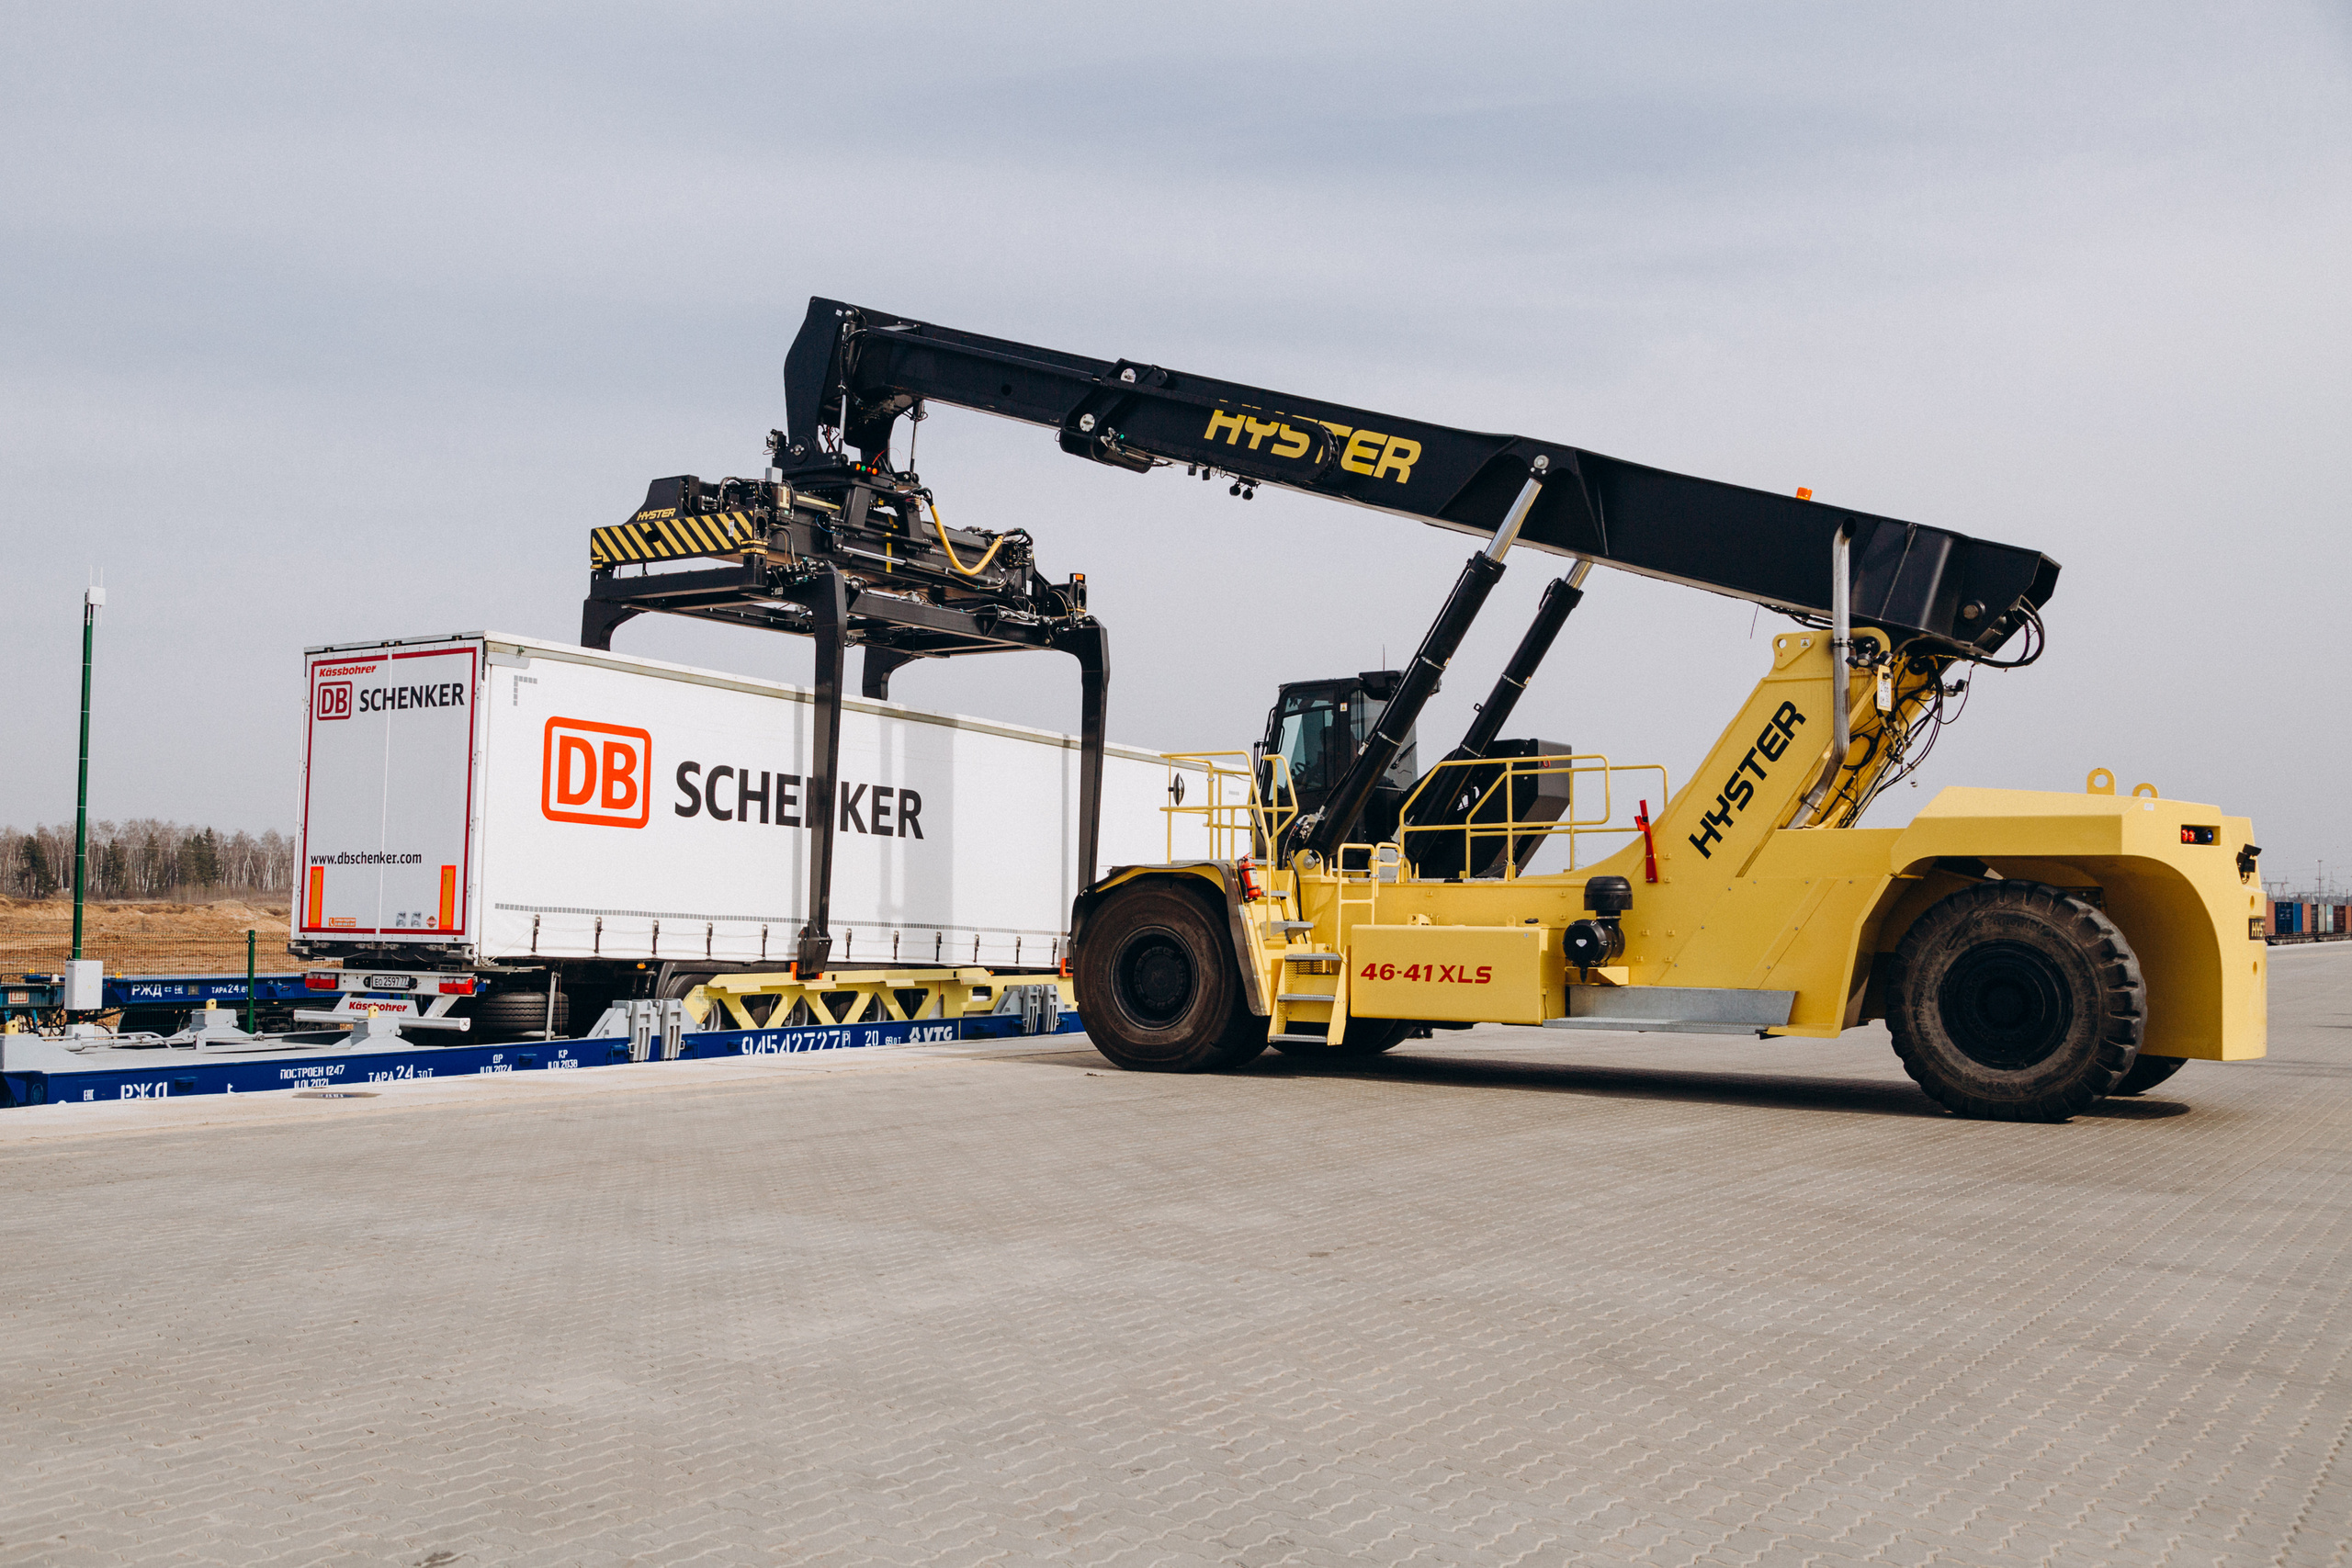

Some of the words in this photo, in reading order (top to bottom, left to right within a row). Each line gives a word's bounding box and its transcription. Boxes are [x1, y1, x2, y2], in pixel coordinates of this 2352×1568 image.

[637, 508, 676, 521] HYSTER
[319, 664, 377, 678] Kässbohrer
[322, 688, 348, 714] DB
[359, 682, 465, 712] SCHENKER
[557, 734, 639, 810] DB
[674, 761, 924, 840] SCHEKER
[1688, 700, 1807, 860] HYSTER
[311, 851, 422, 864] www.dbschenker.com
[131, 984, 163, 998] РЖД
[865, 1030, 879, 1047] 20
[923, 1025, 954, 1042] VTG
[558, 1049, 569, 1059] КР
[280, 1066, 324, 1080] ПОСТРОЕН
[368, 1070, 395, 1082] ТАРА
[120, 1081, 168, 1100] РЖД
